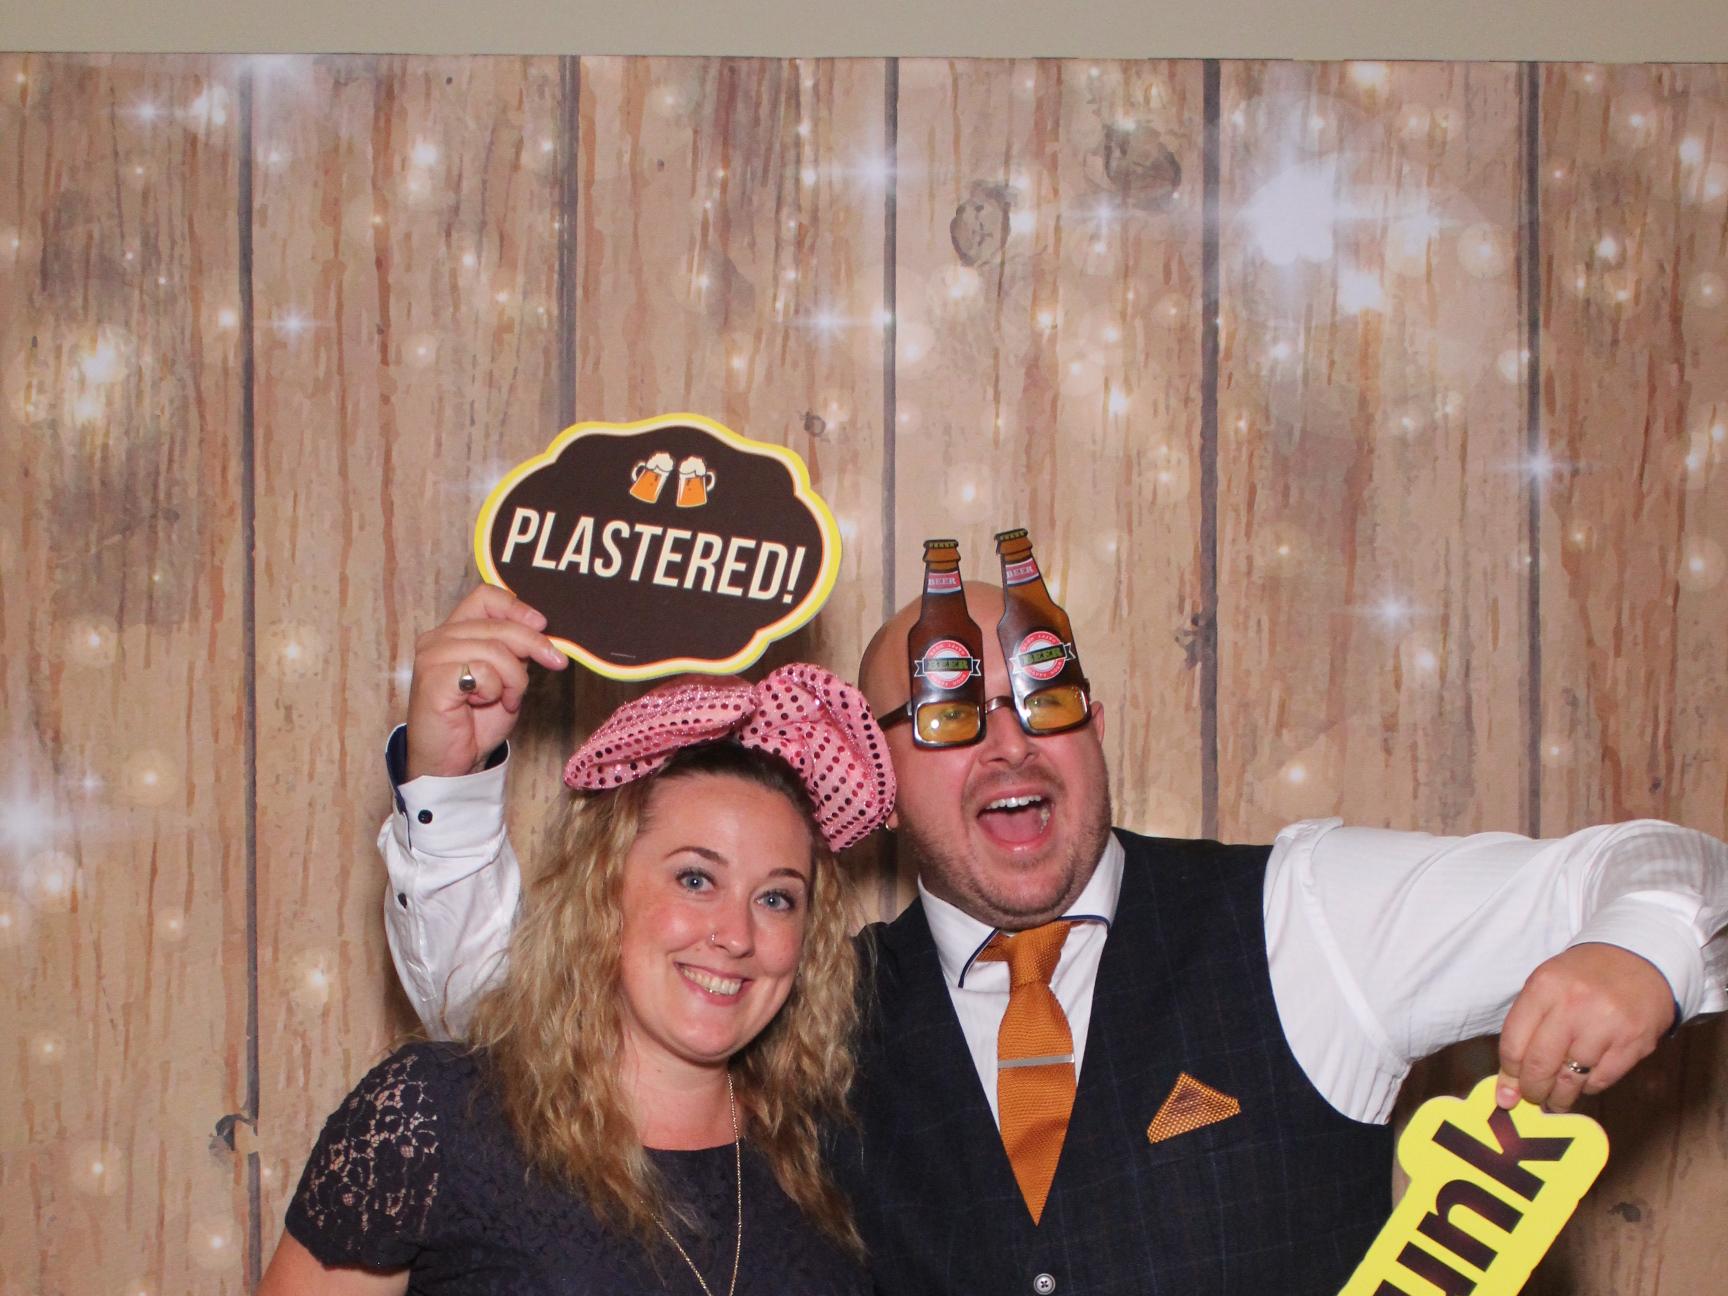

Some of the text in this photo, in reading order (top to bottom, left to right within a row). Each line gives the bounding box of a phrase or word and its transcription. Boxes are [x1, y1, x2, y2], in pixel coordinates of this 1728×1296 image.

[501, 507, 805, 604] PLASTERED!
[1006, 566, 1032, 578] BEER
[928, 577, 956, 585] BEER
